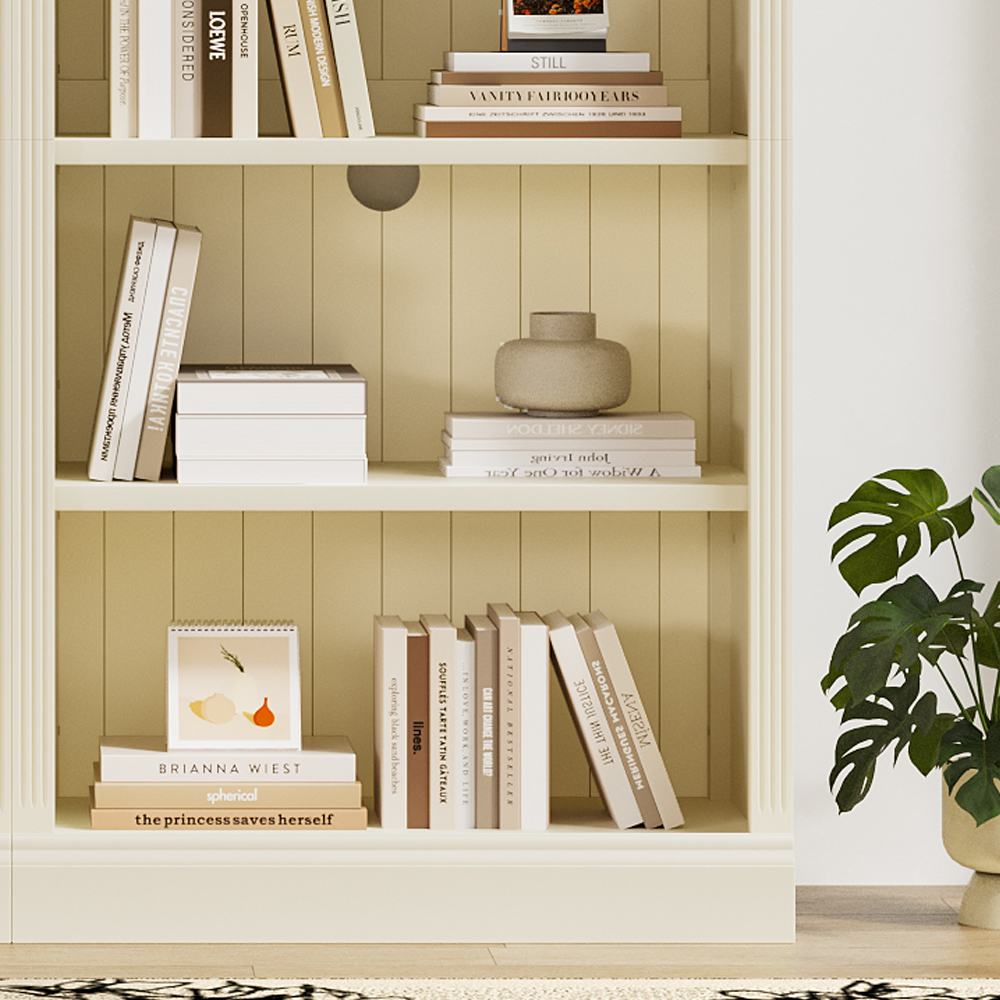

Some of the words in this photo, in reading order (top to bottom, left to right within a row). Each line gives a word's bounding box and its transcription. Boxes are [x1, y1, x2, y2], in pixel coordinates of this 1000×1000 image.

[209, 10, 226, 61] LOEWE
[240, 3, 248, 59] OPENHOUSE
[282, 23, 301, 58] RUM
[309, 17, 326, 56] MODERN
[316, 56, 331, 87] DESIGN
[531, 56, 567, 69] STILL
[438, 661, 450, 705] SOUFFLÉS
[506, 646, 514, 713] NATIONAL
[388, 677, 400, 718] exploring
[391, 718, 401, 741] black
[438, 706, 447, 734] TARTE
[391, 742, 401, 762] sand
[412, 720, 424, 755] lines.
[438, 735, 447, 762] TATIN
[159, 763, 240, 774] BRIANNA
[248, 763, 301, 774] WIEST
[391, 762, 401, 795] beaches
[506, 721, 514, 807] BESTSELLER
[206, 788, 258, 804] spherical
[135, 814, 162, 826] the
[163, 814, 231, 829] princess
[232, 816, 275, 826] saves
[277, 814, 335, 826] herself
